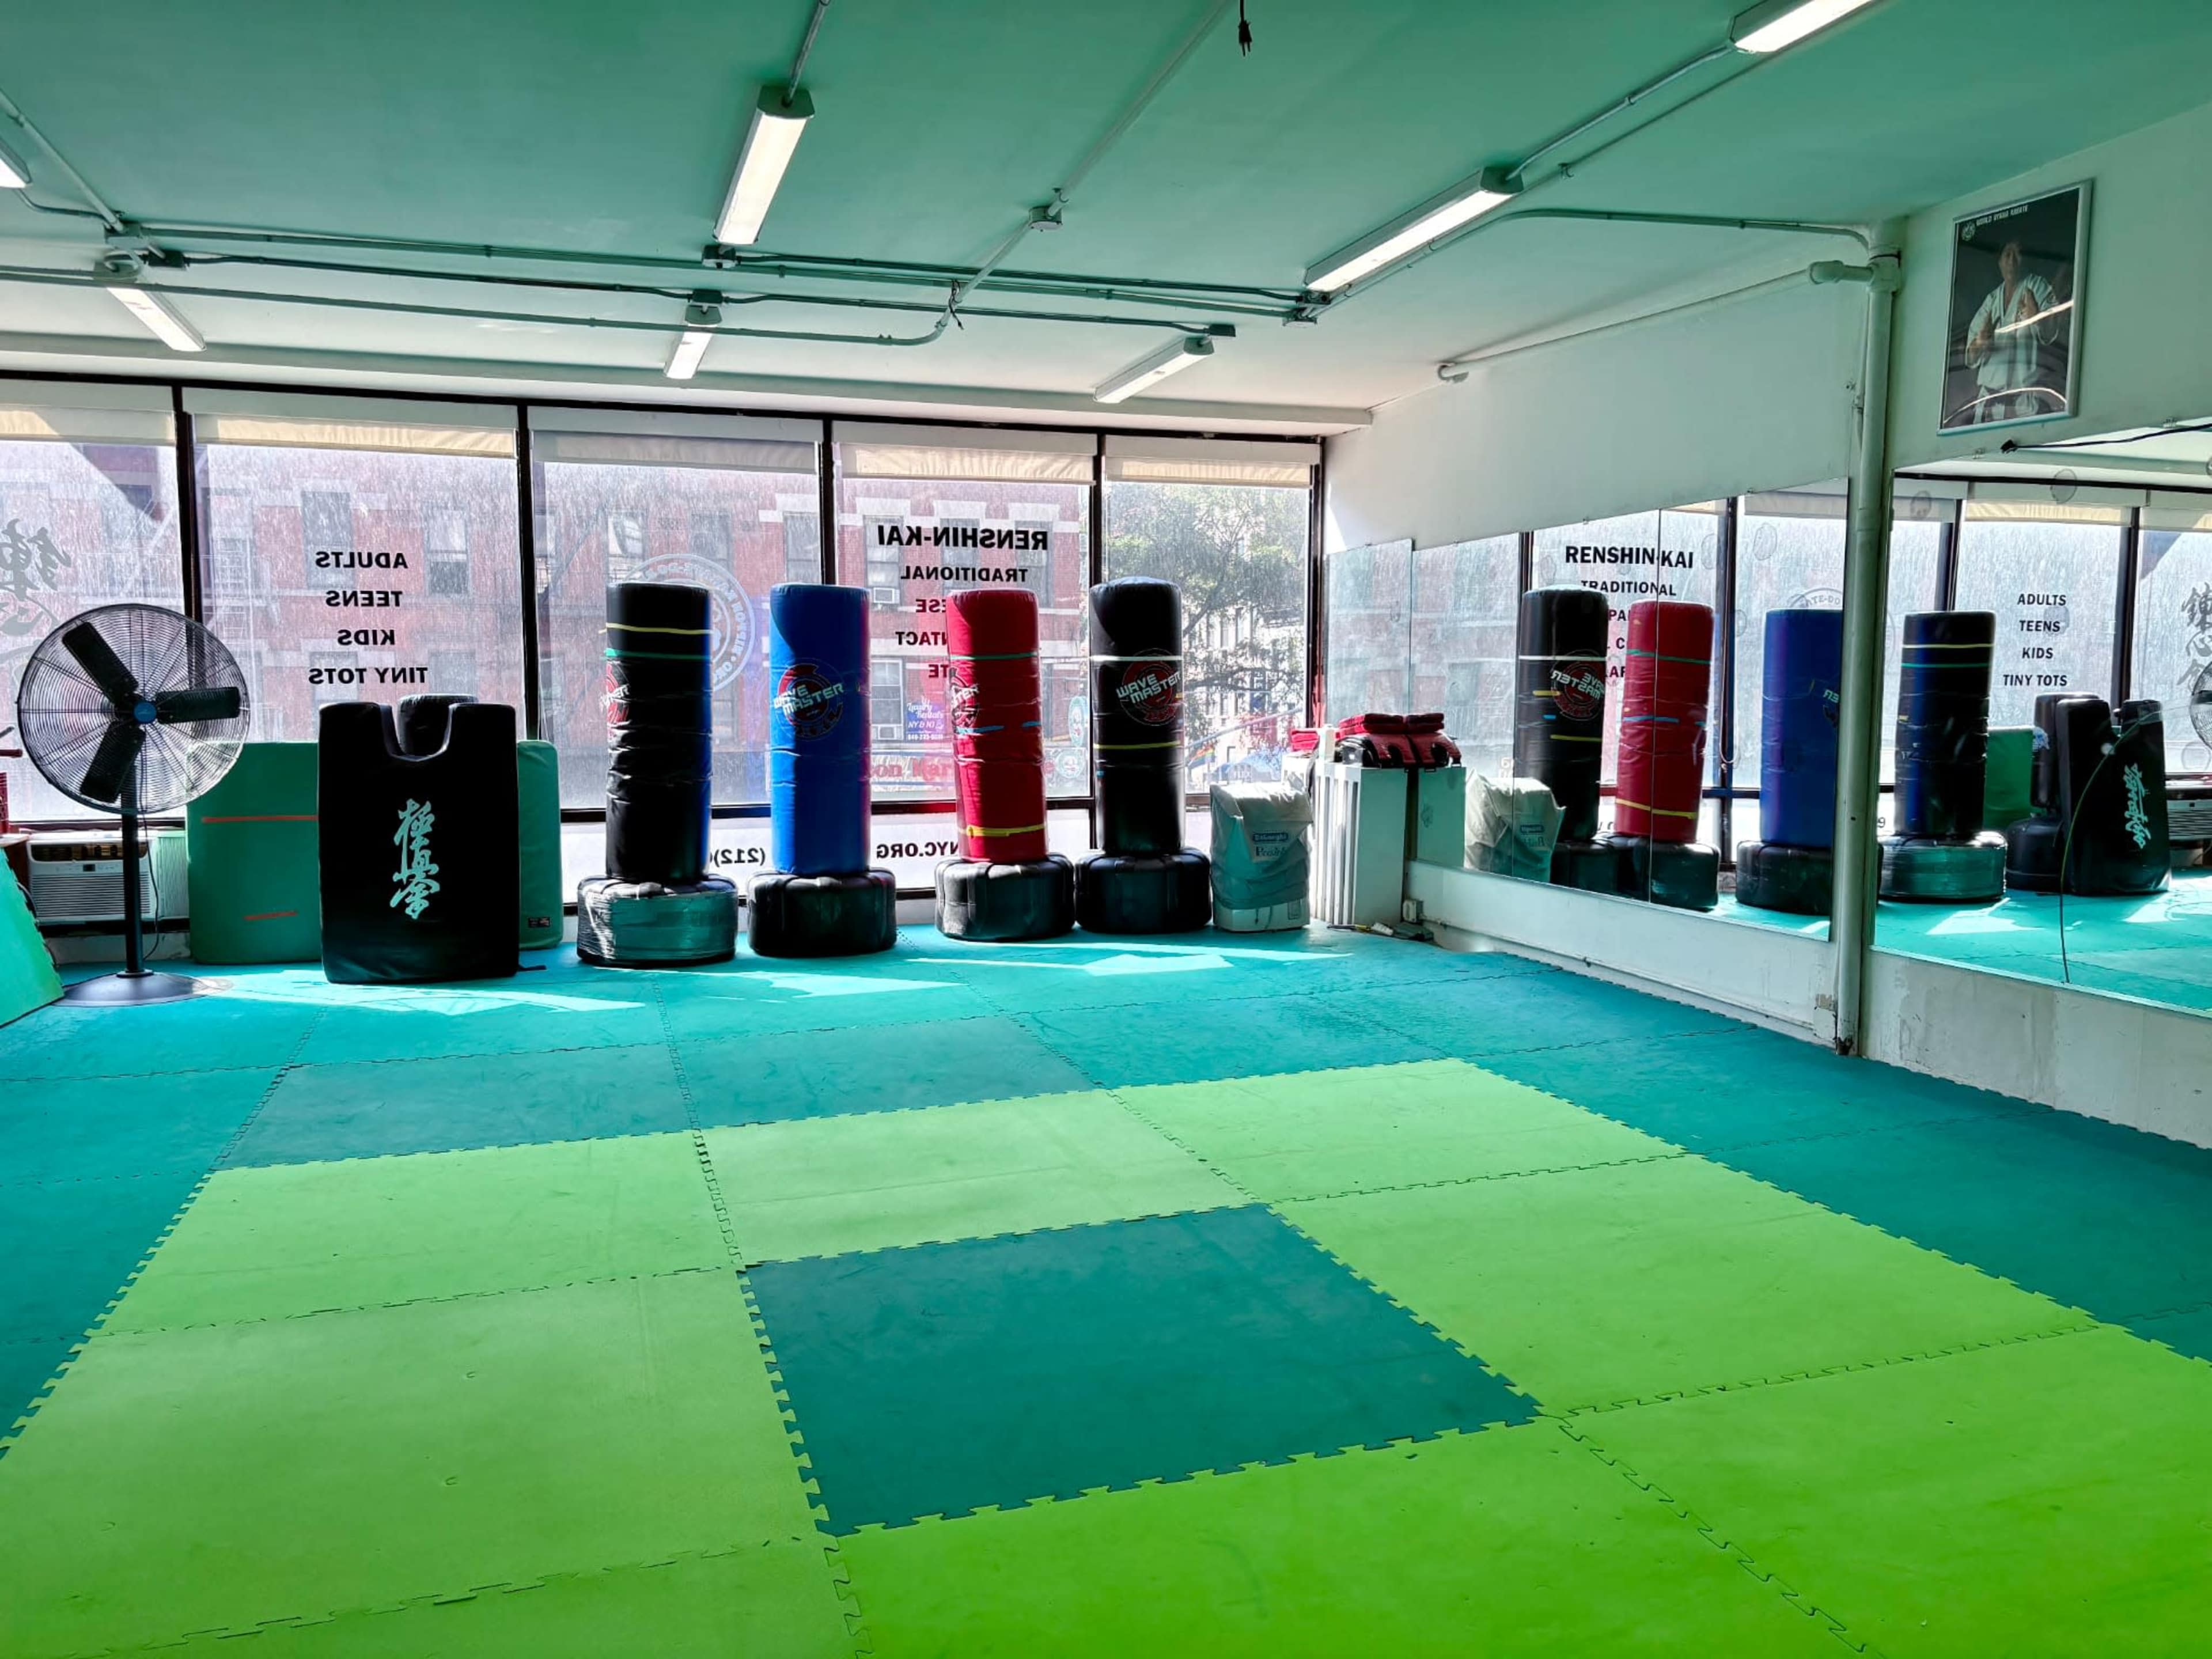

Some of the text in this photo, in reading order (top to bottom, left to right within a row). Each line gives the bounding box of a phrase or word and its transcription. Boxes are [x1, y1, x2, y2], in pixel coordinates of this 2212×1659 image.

[2017, 593, 2067, 606] ADULTS
[2019, 620, 2061, 632] TEENS
[2022, 647, 2054, 660] KIDS
[1116, 673, 1157, 698] WAVE
[2003, 674, 2067, 687] TINY TOTS
[782, 683, 844, 717] MASTER
